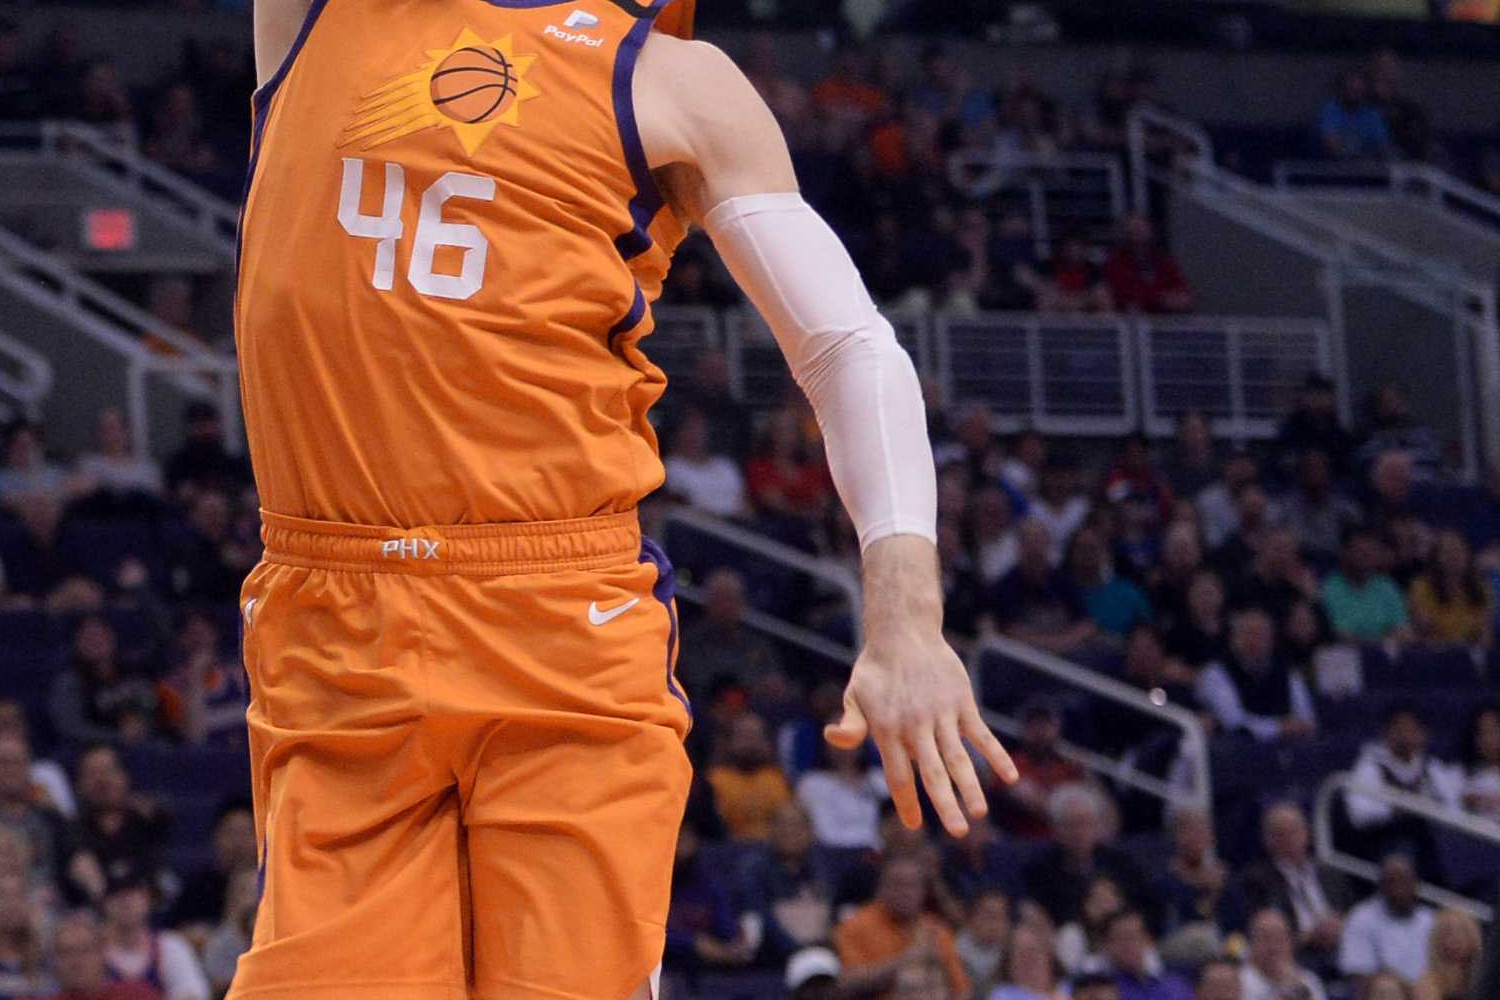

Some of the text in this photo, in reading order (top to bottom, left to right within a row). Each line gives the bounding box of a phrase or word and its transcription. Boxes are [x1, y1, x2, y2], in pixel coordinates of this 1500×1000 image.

[544, 25, 604, 47] PayPal
[337, 157, 496, 300] 46
[382, 538, 441, 560] PHX
